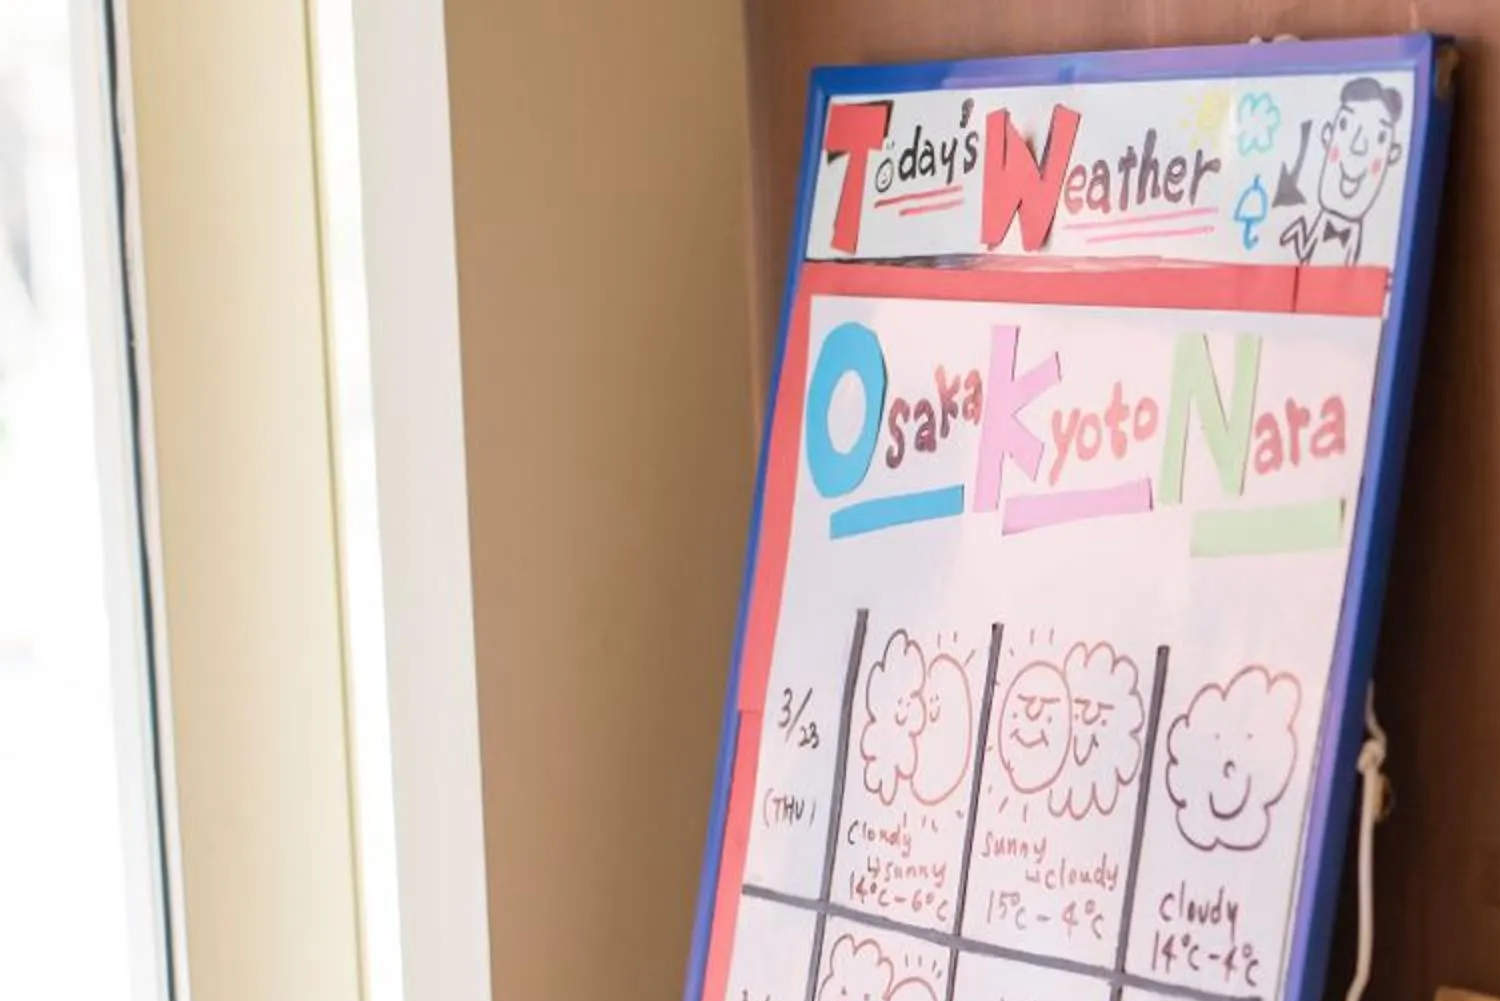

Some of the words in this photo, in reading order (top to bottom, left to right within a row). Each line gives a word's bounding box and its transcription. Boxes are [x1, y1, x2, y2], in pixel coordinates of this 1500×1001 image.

[824, 98, 978, 254] Today's
[980, 103, 1222, 252] Weather
[806, 321, 985, 498] Osaka
[972, 324, 1160, 513] Kyoto
[1158, 332, 1348, 506] Nara
[778, 688, 820, 749] 3/23
[763, 787, 816, 832] (THU)
